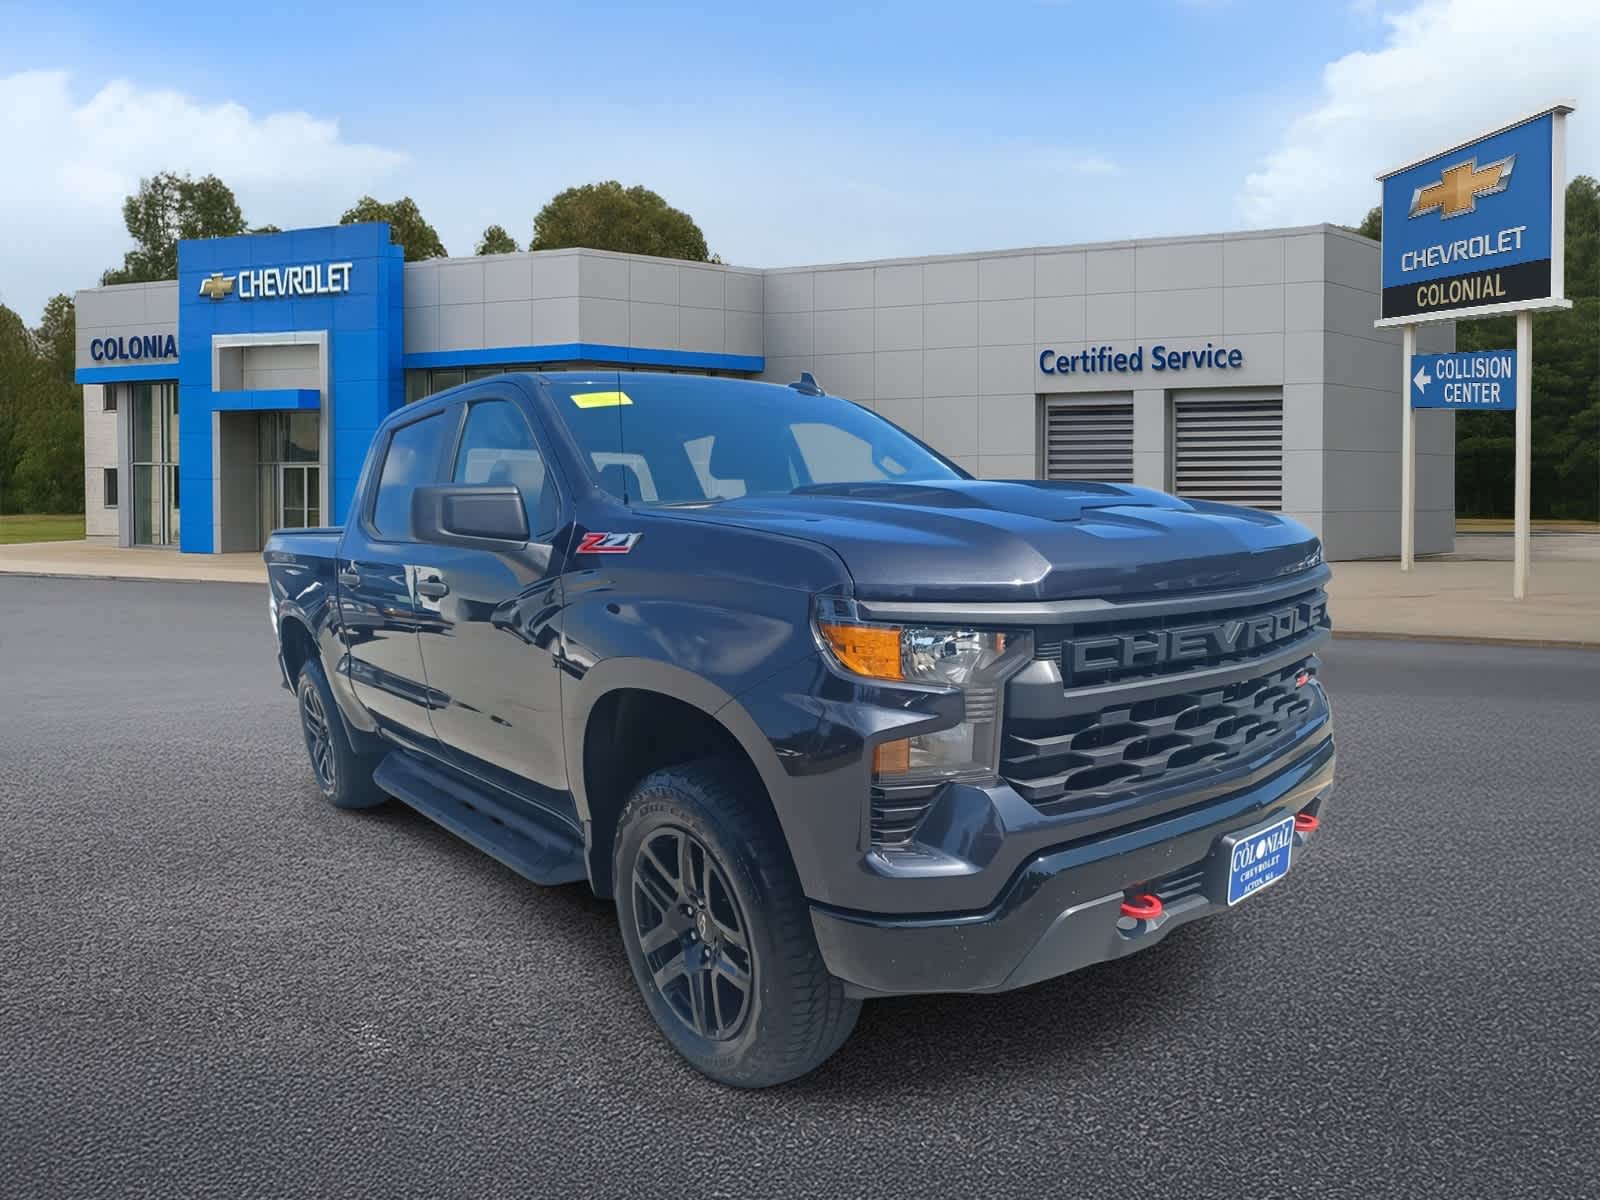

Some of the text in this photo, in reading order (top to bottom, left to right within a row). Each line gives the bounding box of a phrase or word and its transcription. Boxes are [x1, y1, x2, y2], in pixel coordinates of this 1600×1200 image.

[1401, 225, 1527, 272] CHEVROLET
[238, 262, 353, 299] CHEVROLET
[1416, 273, 1507, 308] COLONIAL
[90, 334, 179, 361] COLONIA
[1039, 343, 1243, 375] Certified Service
[1436, 356, 1512, 379] COLLISION
[1444, 382, 1501, 403] CENTER
[575, 531, 643, 554] Z71
[1064, 592, 1328, 673] CHEVROLE
[1233, 825, 1290, 872] COLONIAL
[1240, 854, 1280, 882] CHEVROLET
